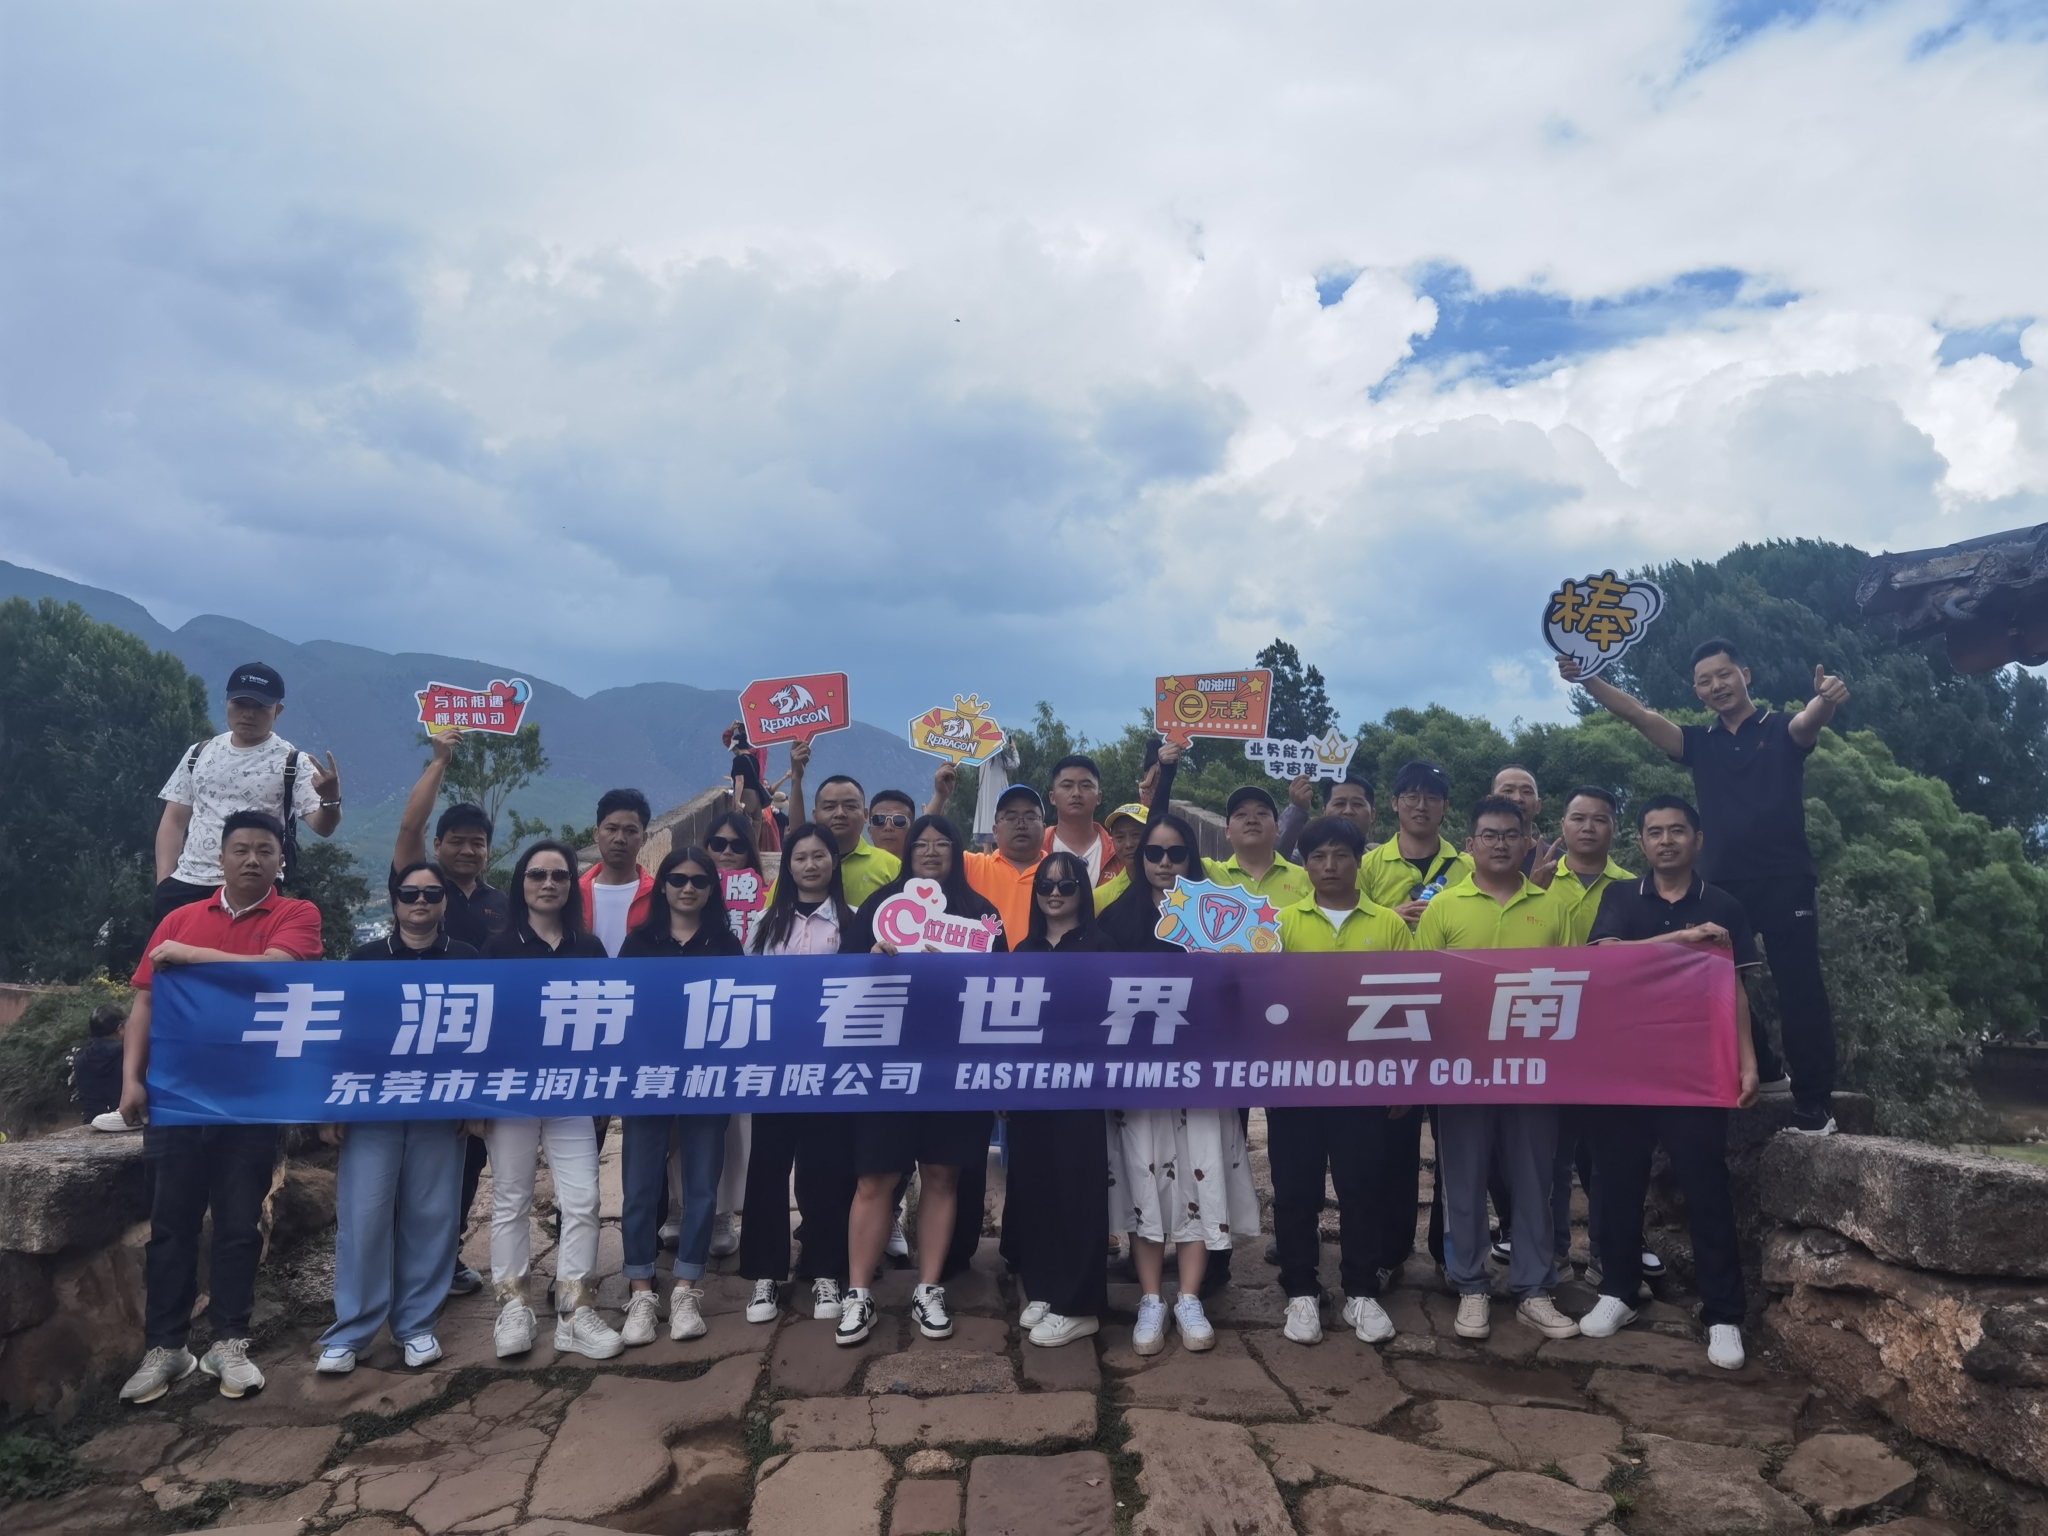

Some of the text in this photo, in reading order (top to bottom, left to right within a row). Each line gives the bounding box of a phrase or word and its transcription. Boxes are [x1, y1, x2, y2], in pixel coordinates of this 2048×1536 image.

[1551, 574, 1637, 651] 棒
[1198, 678, 1236, 692] 加油!!!
[434, 695, 504, 709] 与你相遇
[435, 712, 505, 725] 怦然心动
[760, 705, 832, 734] REDRAGON
[926, 732, 978, 756] REDRAGON
[1250, 742, 1315, 760] 业务能力
[878, 899, 991, 952] C位出道
[323, 1057, 1547, 1105] 东莞市丰润计算机有限公司 EASTERN TIMES TECHNOLOGY CO.,LTD
